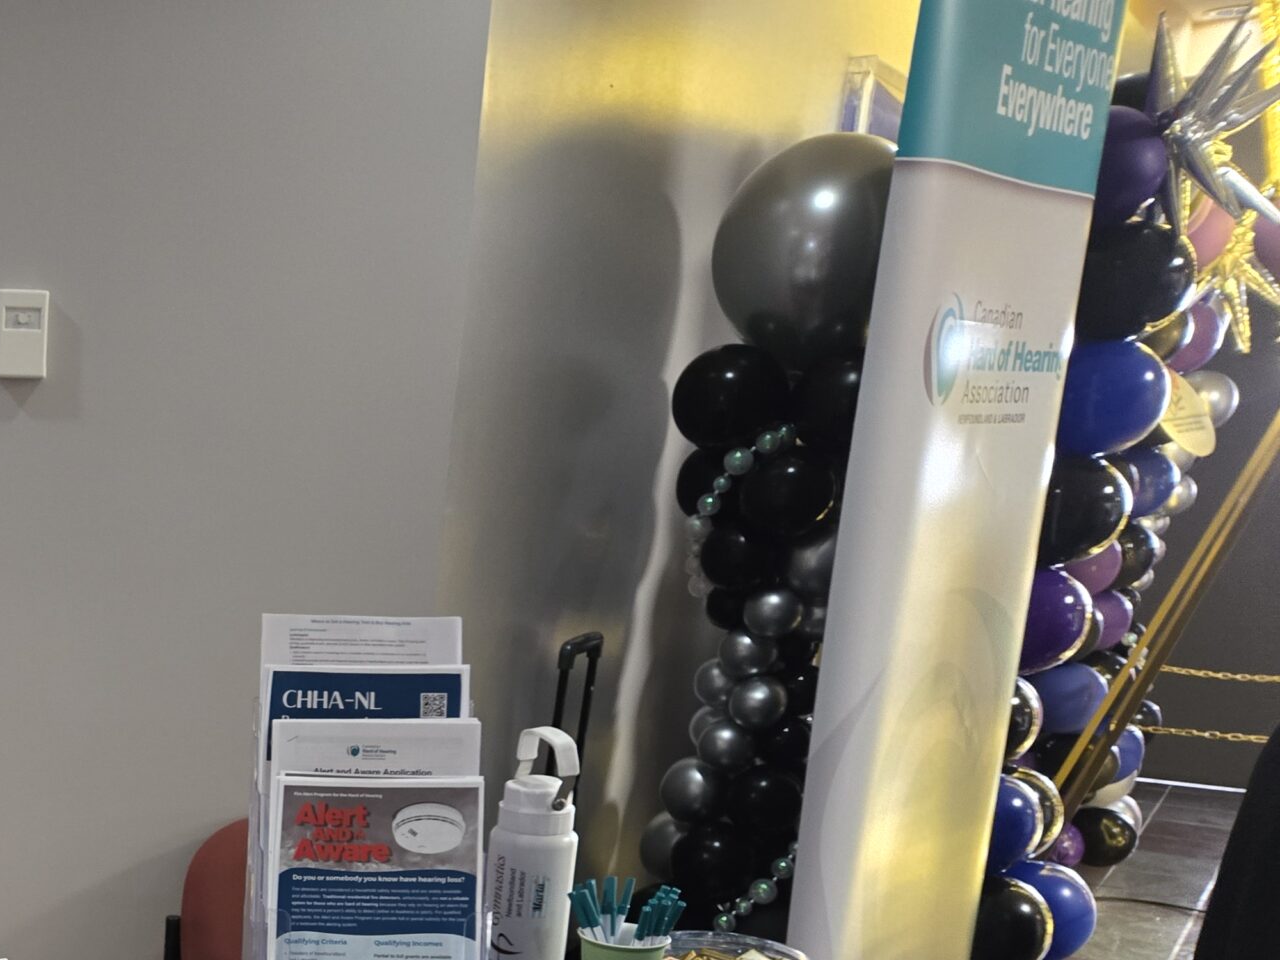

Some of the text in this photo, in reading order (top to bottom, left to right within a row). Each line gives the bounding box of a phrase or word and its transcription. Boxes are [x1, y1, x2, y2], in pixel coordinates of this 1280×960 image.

[1021, 12, 1114, 92] for Everyone
[996, 63, 1094, 140] Everywhere
[974, 300, 1023, 330] Canadian
[997, 340, 1013, 372] of
[961, 380, 1030, 404] Association
[282, 689, 383, 710] CHHA-NL
[295, 800, 369, 827] Alert
[313, 828, 353, 842] AND
[293, 838, 392, 863] Aware
[326, 874, 363, 883] somebody
[418, 876, 446, 884] hearing
